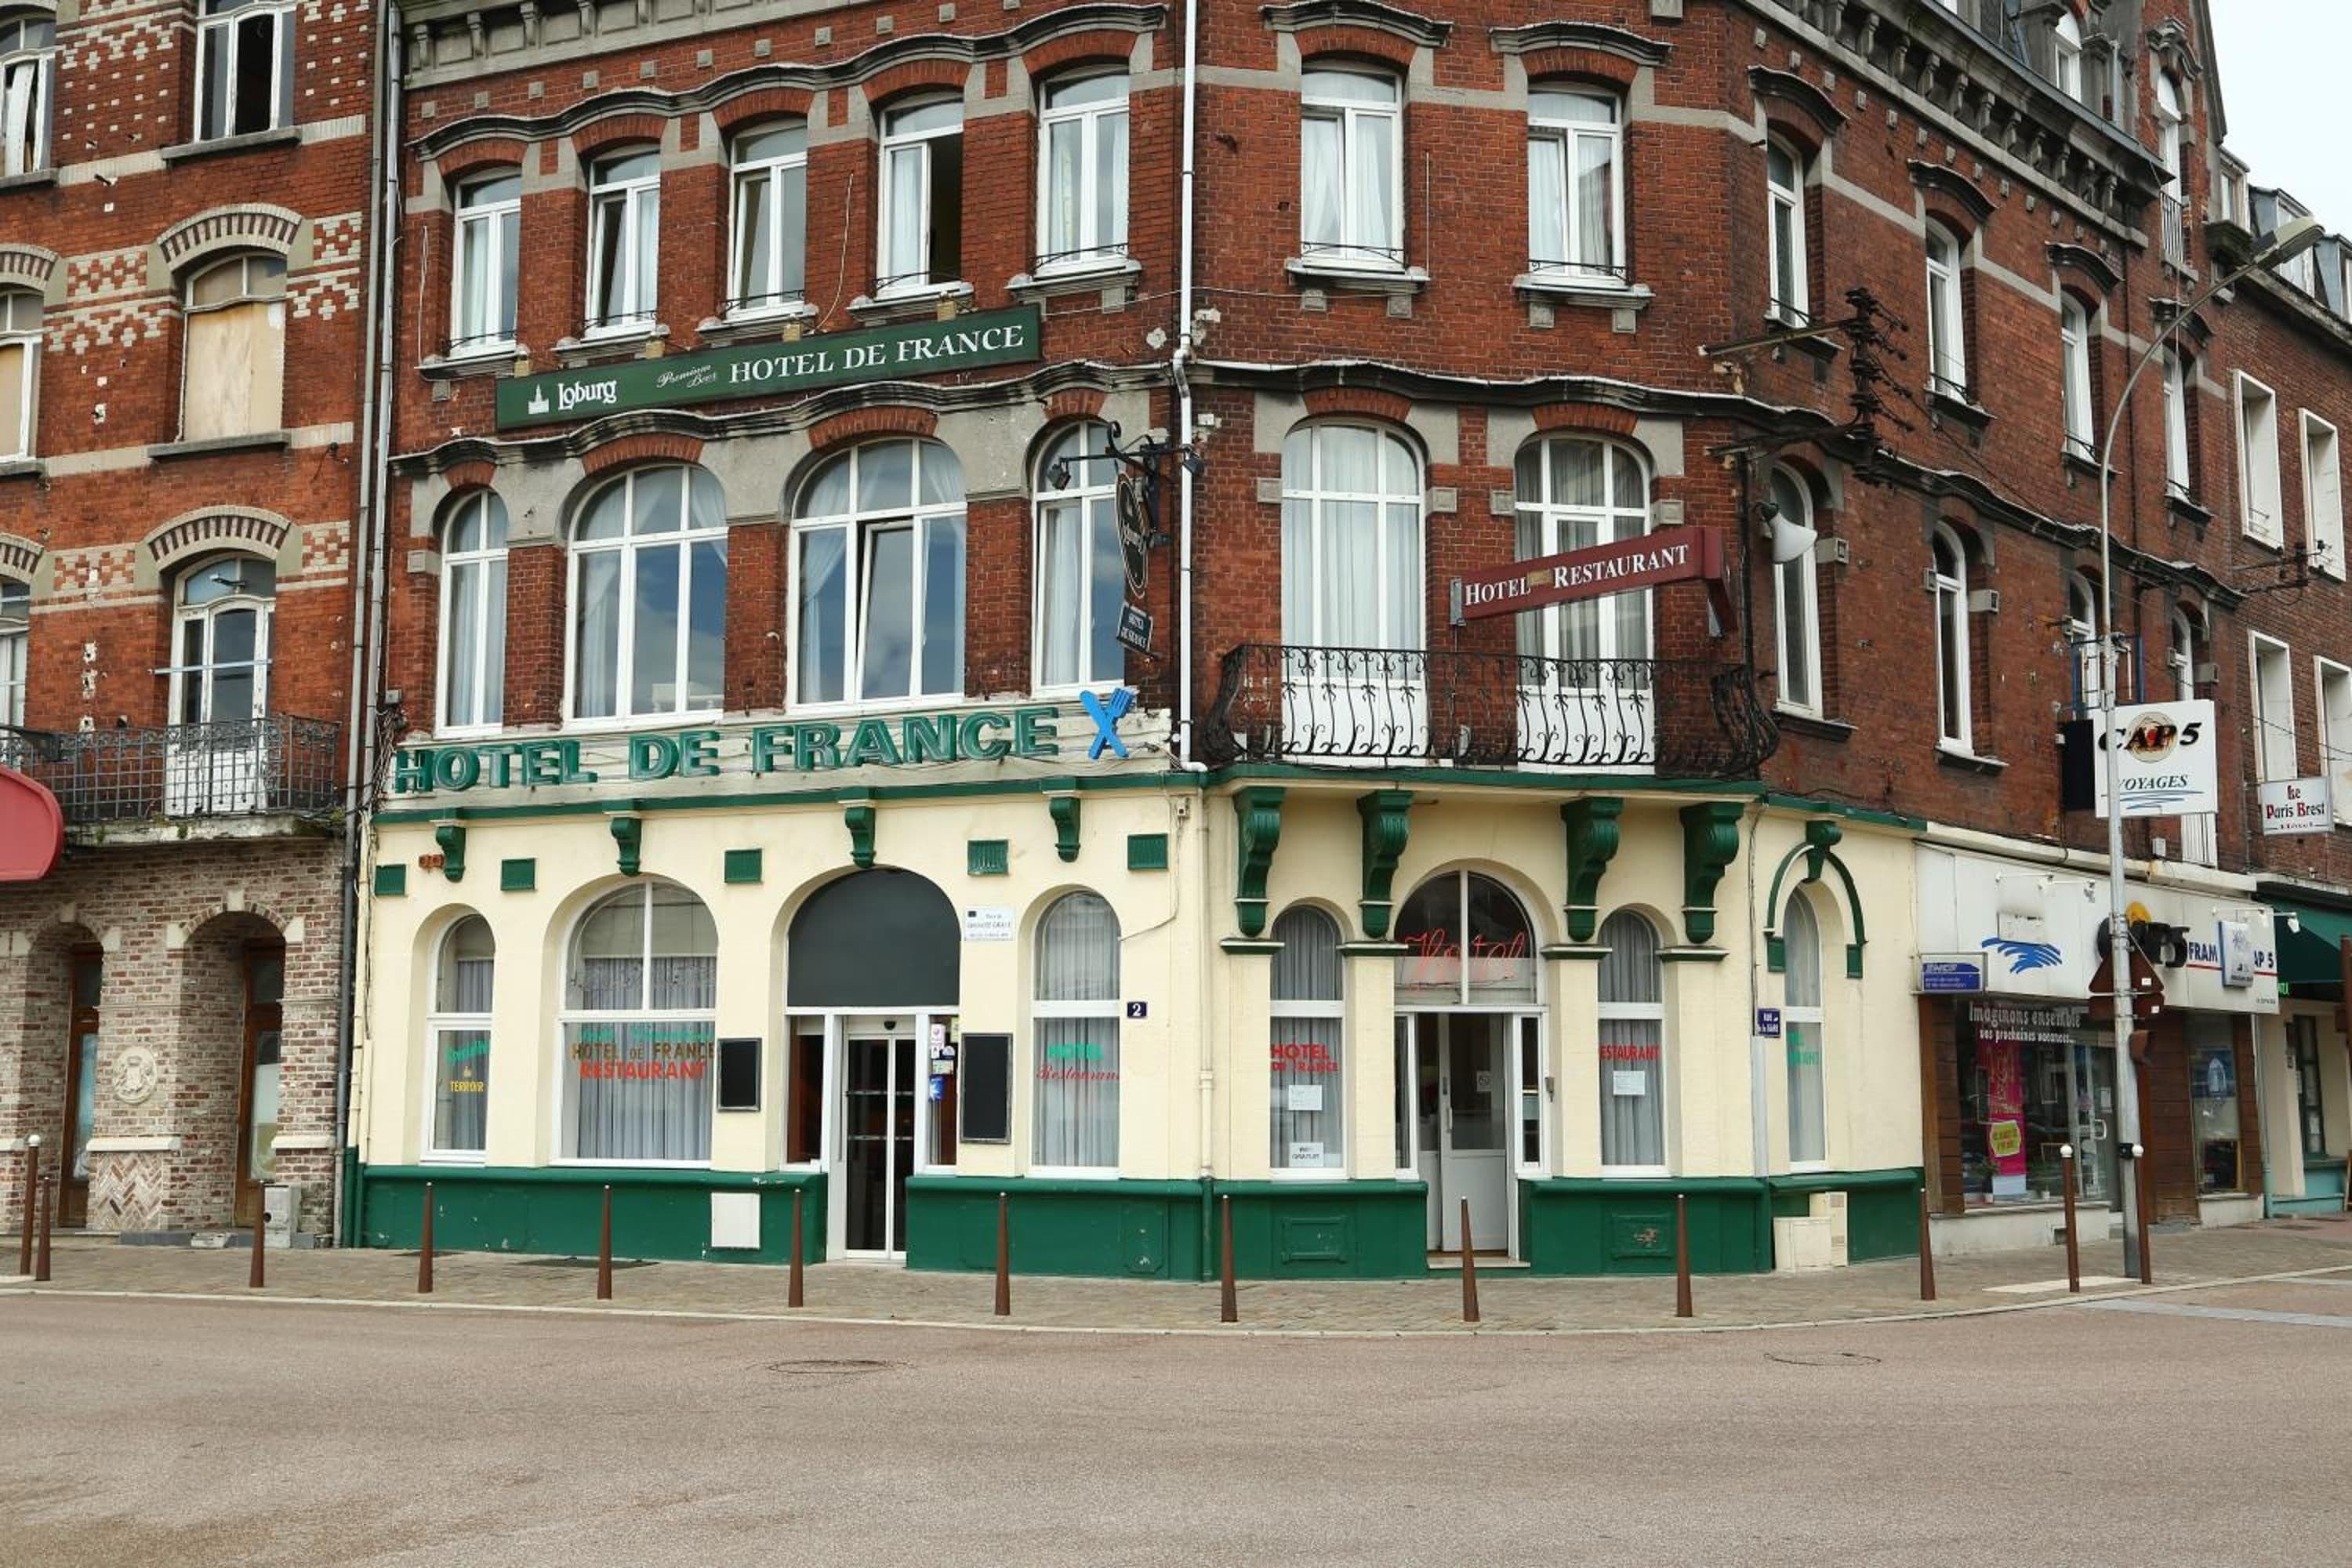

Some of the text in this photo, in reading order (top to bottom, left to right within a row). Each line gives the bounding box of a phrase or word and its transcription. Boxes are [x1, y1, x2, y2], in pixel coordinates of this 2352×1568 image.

[728, 325, 1023, 384] HOTEL DE FRANCE
[557, 380, 618, 412] Loburg
[1465, 544, 1689, 607] HOTEL RESTAURANT
[2179, 721, 2202, 746] 5
[394, 706, 1059, 794] HOTEL DE FRANCE
[2120, 775, 2188, 791] OYAGES
[2267, 801, 2325, 819] Paris Brest
[2188, 942, 2218, 963] FRAM
[2267, 951, 2274, 969] 5
[1132, 1003, 1142, 1017] 2
[1969, 1003, 2029, 1028] Imaginons
[572, 1043, 618, 1060] HOTEL
[652, 1042, 716, 1060] FRANCE
[1599, 1044, 1660, 1061] ESTAURANT
[580, 1061, 705, 1080] RESTAURANT
